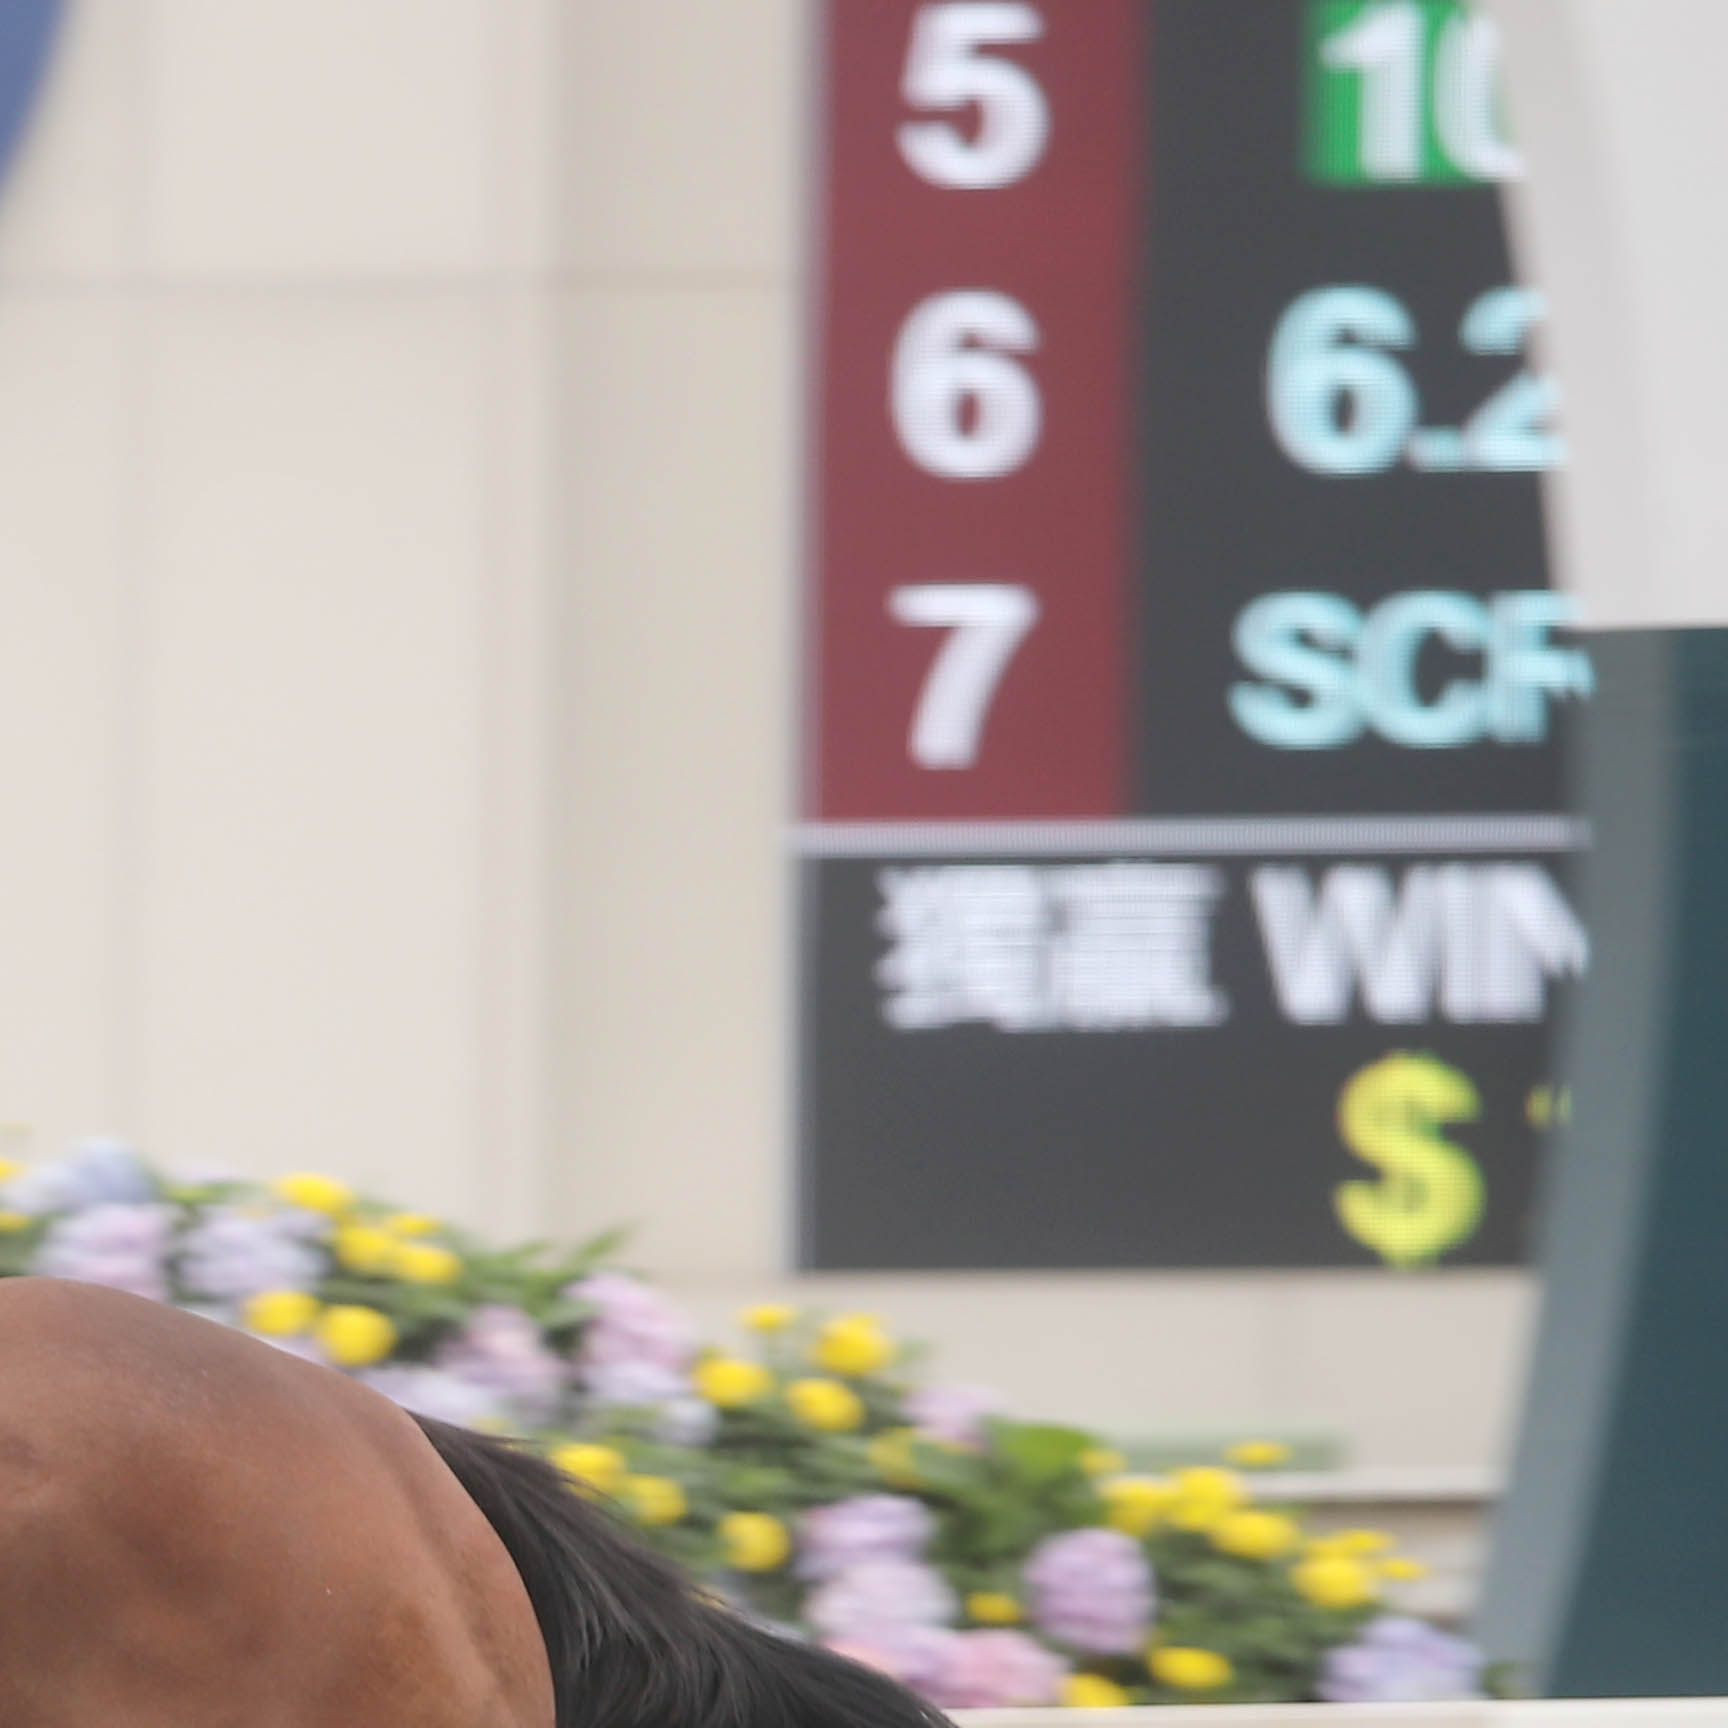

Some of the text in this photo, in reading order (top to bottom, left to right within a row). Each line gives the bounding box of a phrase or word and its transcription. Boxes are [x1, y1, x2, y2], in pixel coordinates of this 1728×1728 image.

[894, 2, 1050, 189] 5
[890, 285, 1569, 479] 6 6.2
[889, 583, 1039, 768] 7
